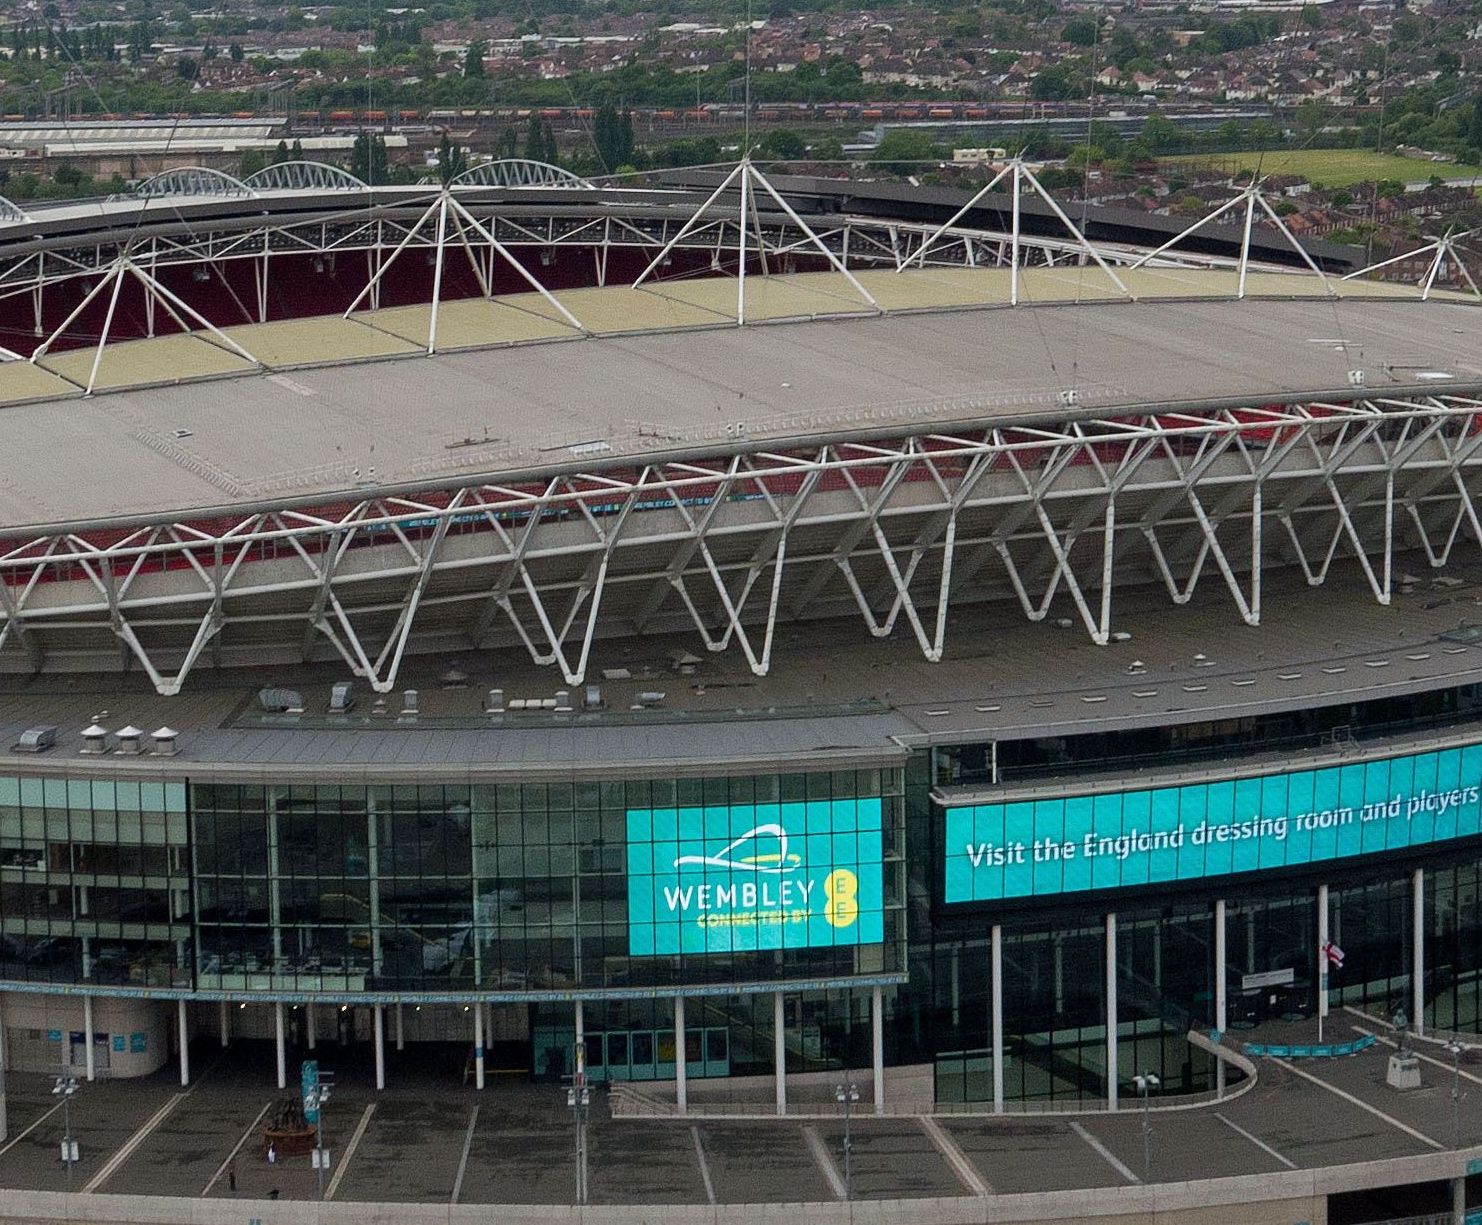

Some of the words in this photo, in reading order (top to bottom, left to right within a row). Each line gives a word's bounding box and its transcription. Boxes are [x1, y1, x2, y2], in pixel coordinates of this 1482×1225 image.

[967, 840, 1025, 867] Visit
[1033, 837, 1076, 862] the
[1084, 824, 1184, 860] England
[1191, 815, 1287, 846] dressing
[1295, 807, 1353, 831] room
[1360, 794, 1400, 822] and
[664, 879, 814, 911] WEMBLEY
[697, 911, 788, 928] CONNECTED
